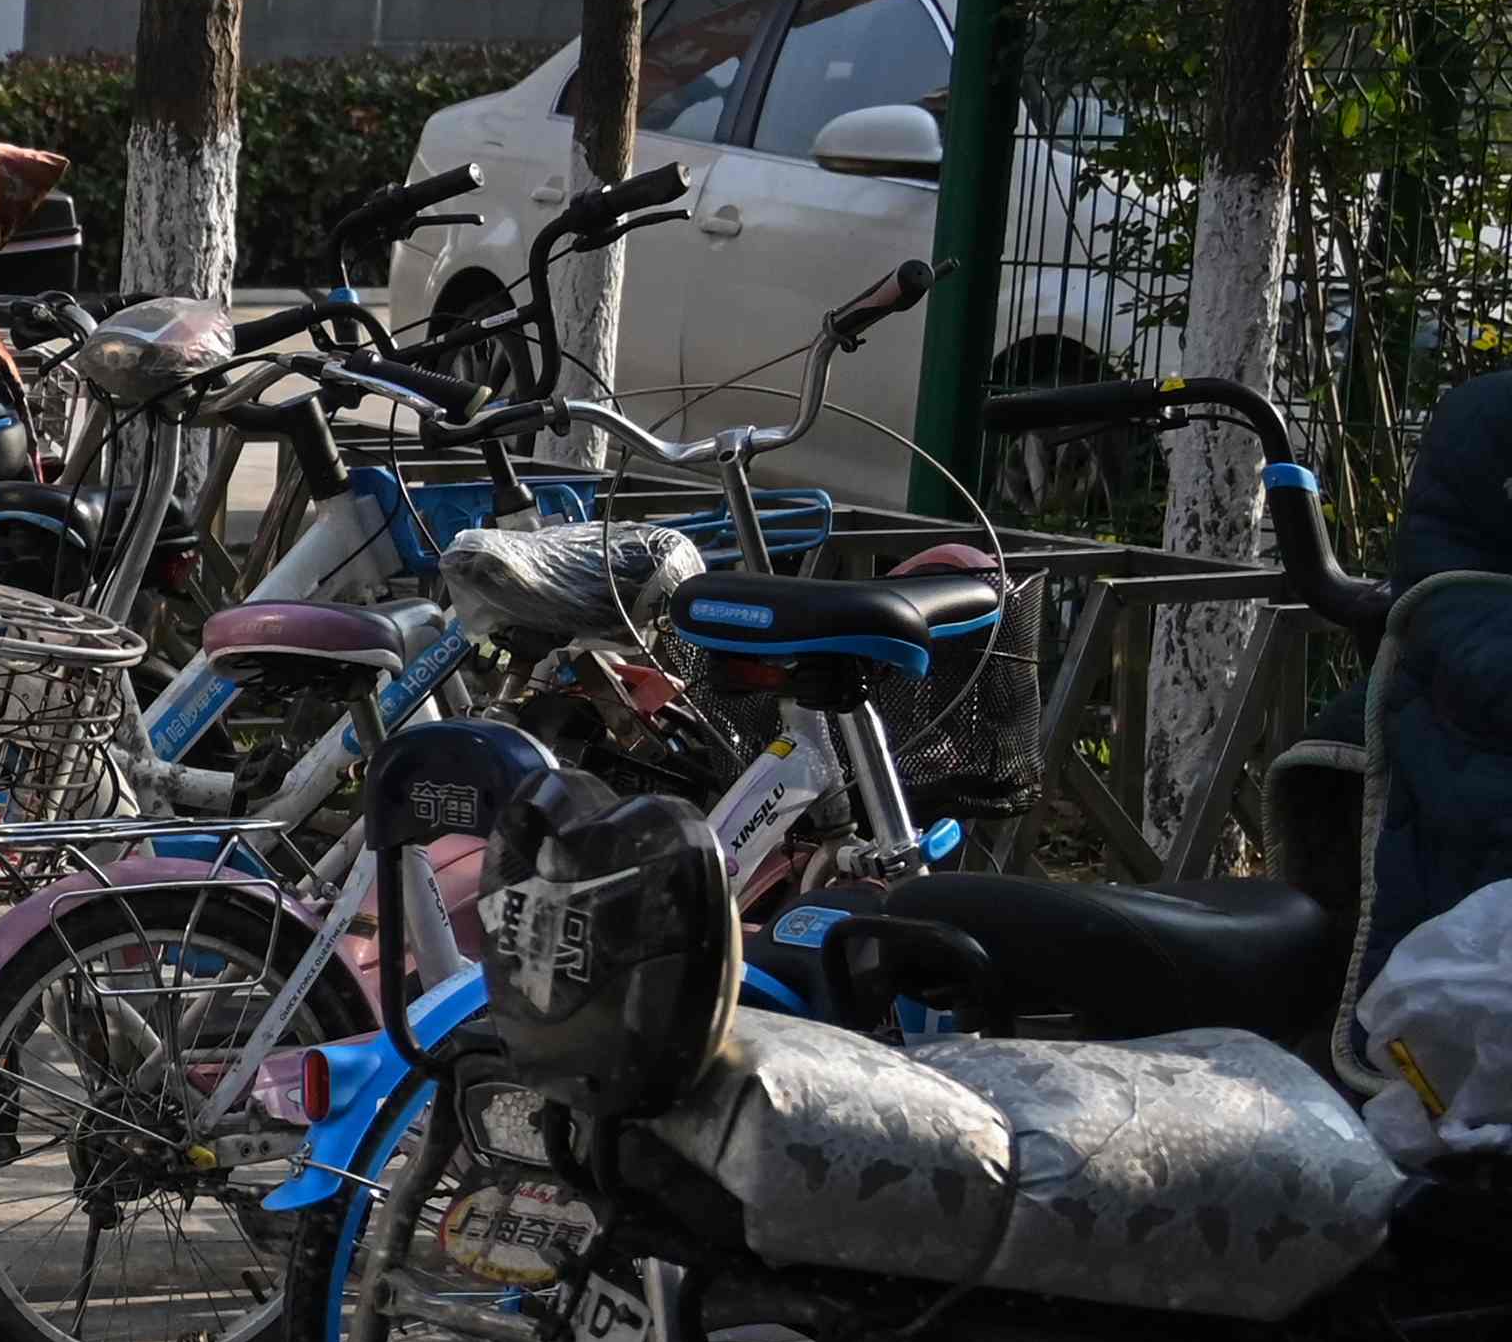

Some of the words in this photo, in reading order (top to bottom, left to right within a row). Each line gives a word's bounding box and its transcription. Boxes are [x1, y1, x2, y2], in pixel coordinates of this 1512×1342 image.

[408, 779, 478, 828] 奇蕾
[730, 782, 785, 855] XINSILU
[295, 966, 318, 995] FORCE
